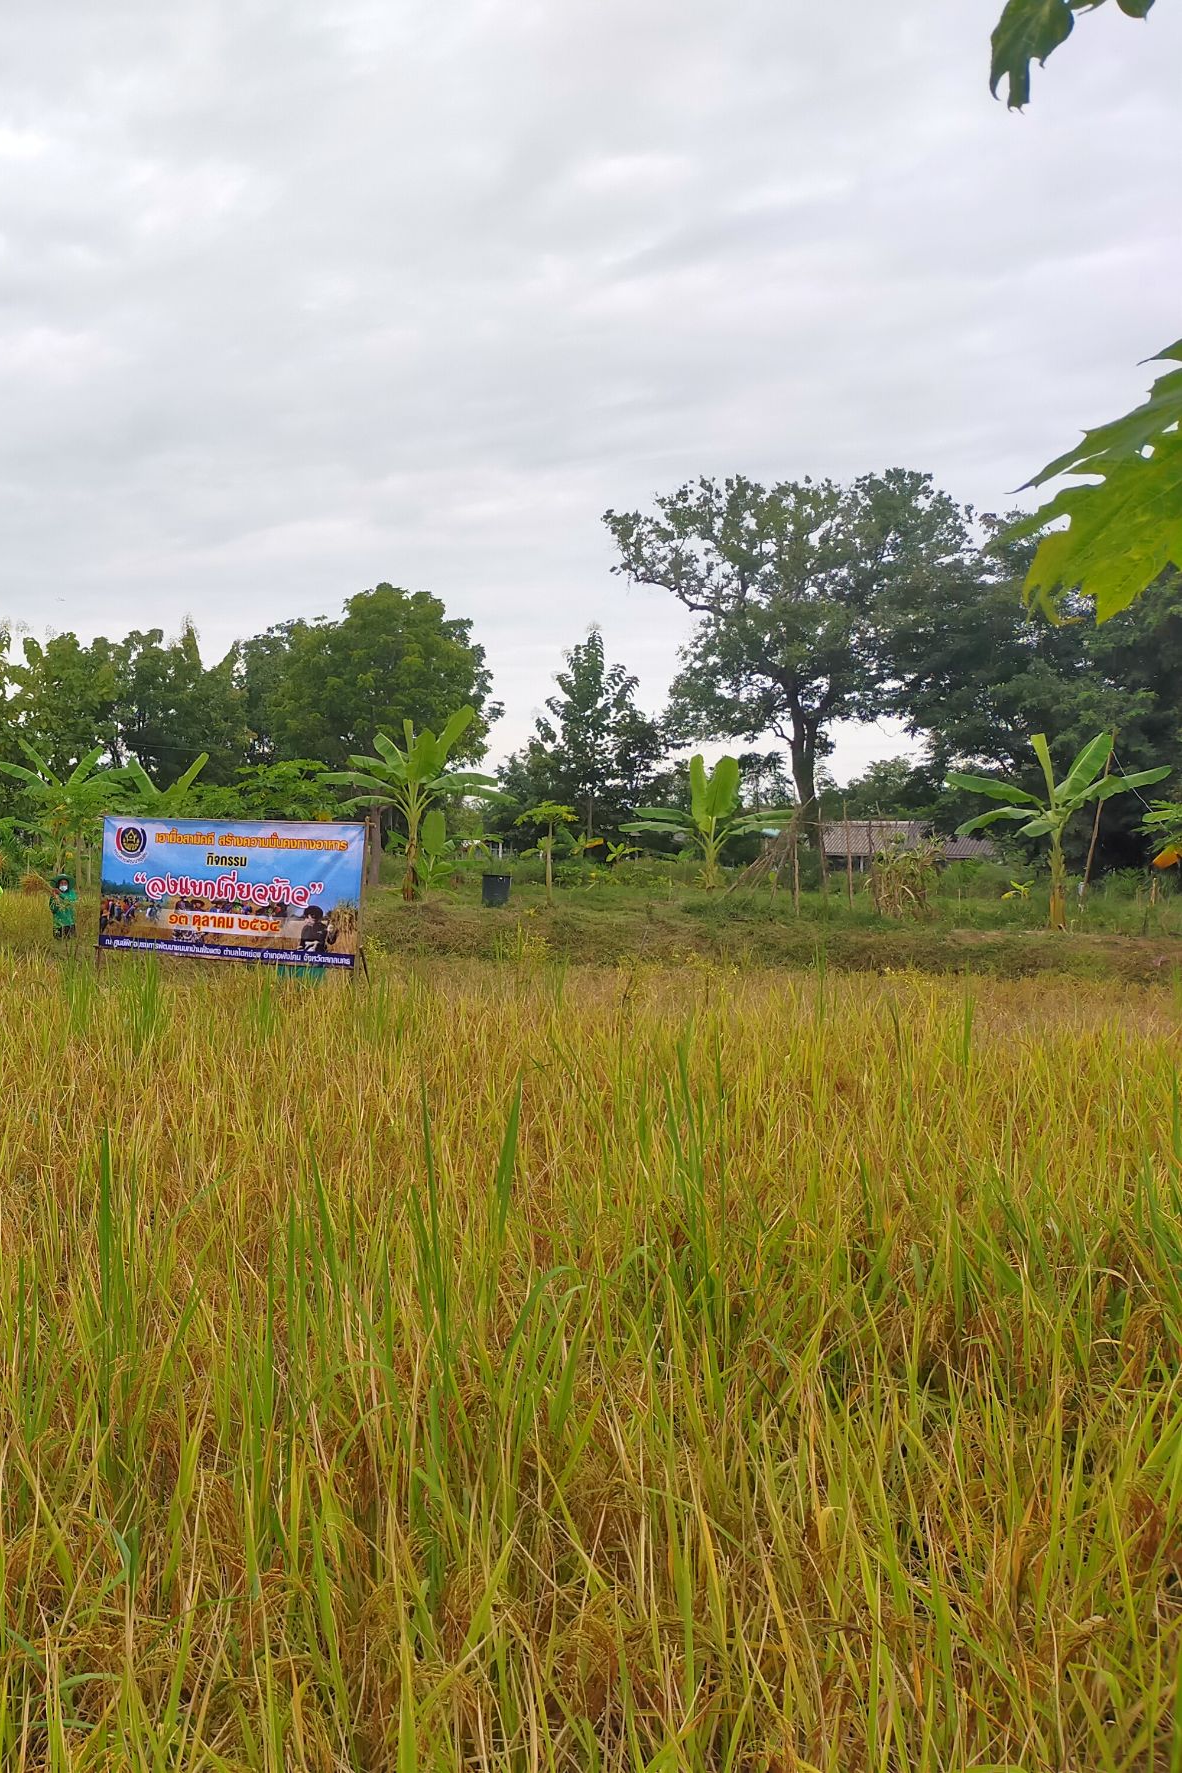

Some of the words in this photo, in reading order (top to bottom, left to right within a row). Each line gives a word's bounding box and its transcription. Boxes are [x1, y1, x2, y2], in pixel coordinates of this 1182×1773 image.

[206, 853, 247, 867] กิจกรรม
[168, 913, 188, 925] ๑๓
[192, 914, 234, 931] ตุลาคม
